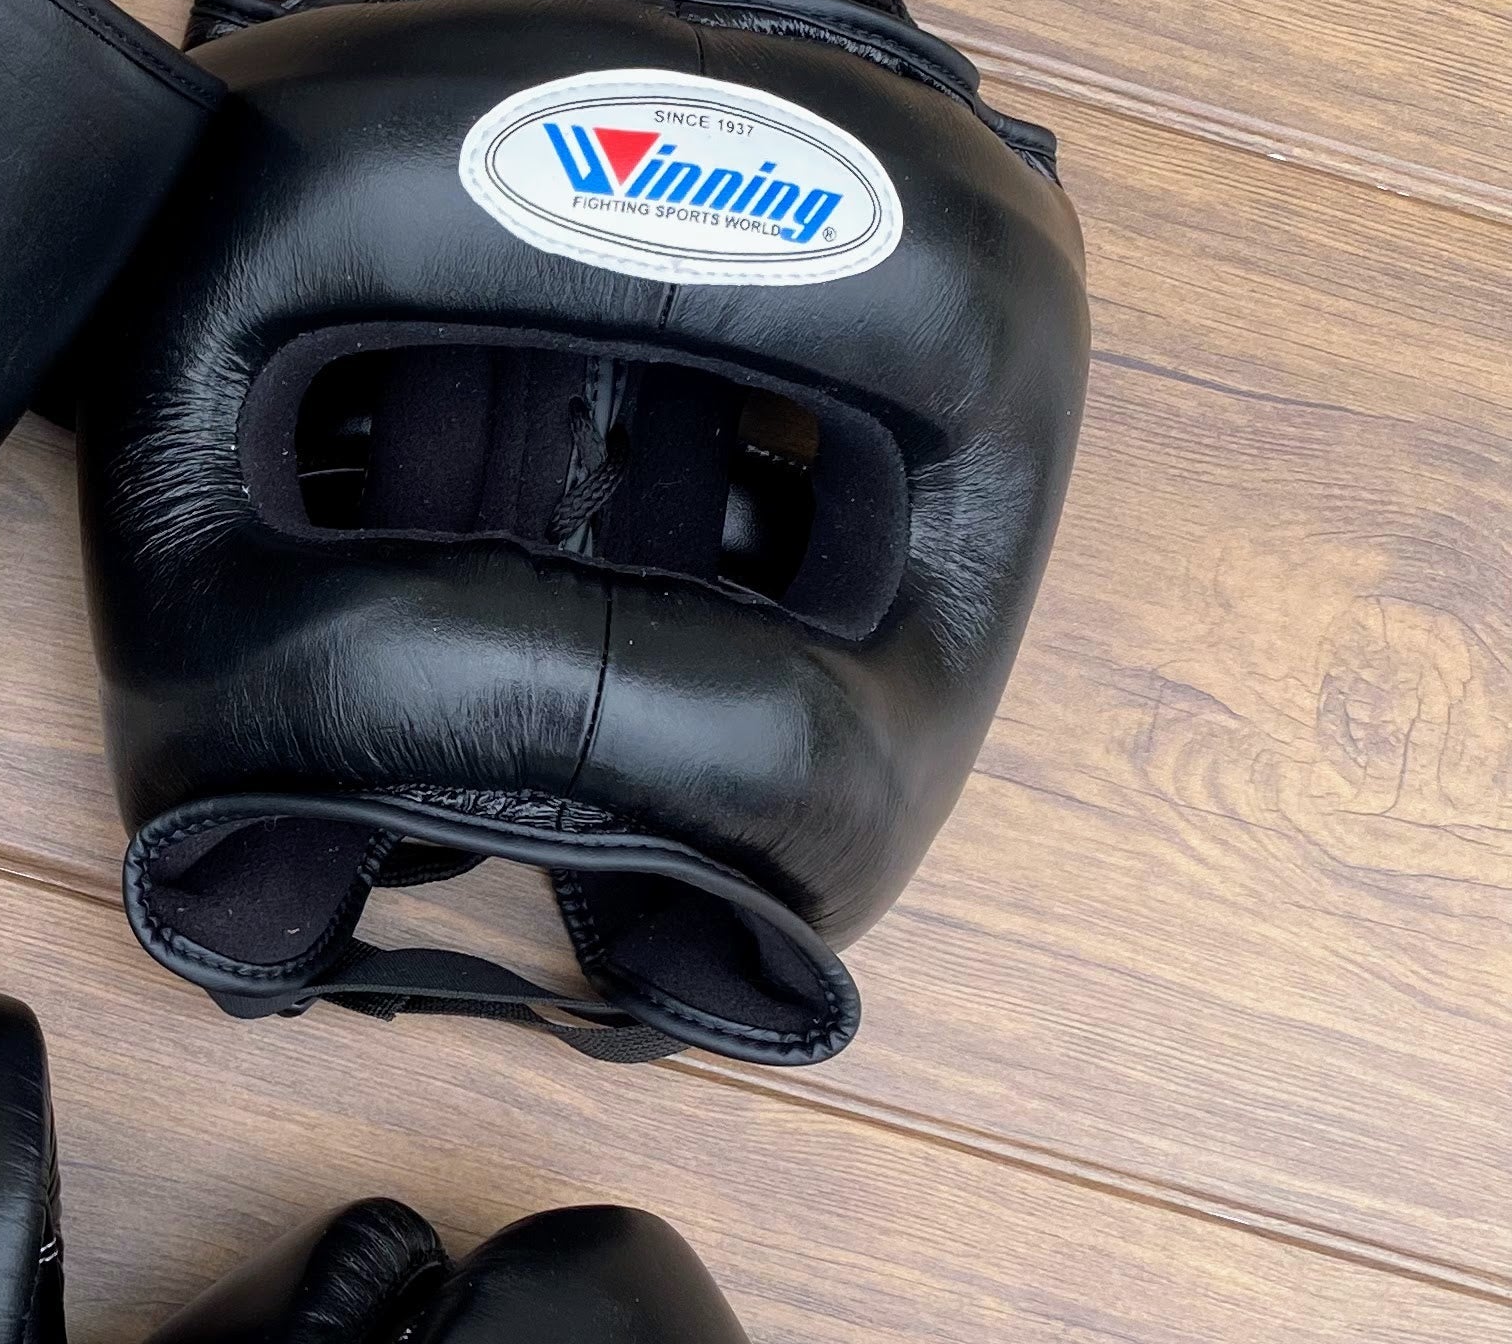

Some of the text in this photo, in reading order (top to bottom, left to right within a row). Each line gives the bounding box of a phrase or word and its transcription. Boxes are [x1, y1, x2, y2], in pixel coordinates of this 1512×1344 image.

[654, 109, 755, 138] SINCE 1937
[572, 195, 780, 237] FIGHTING SPORTS WORLD
